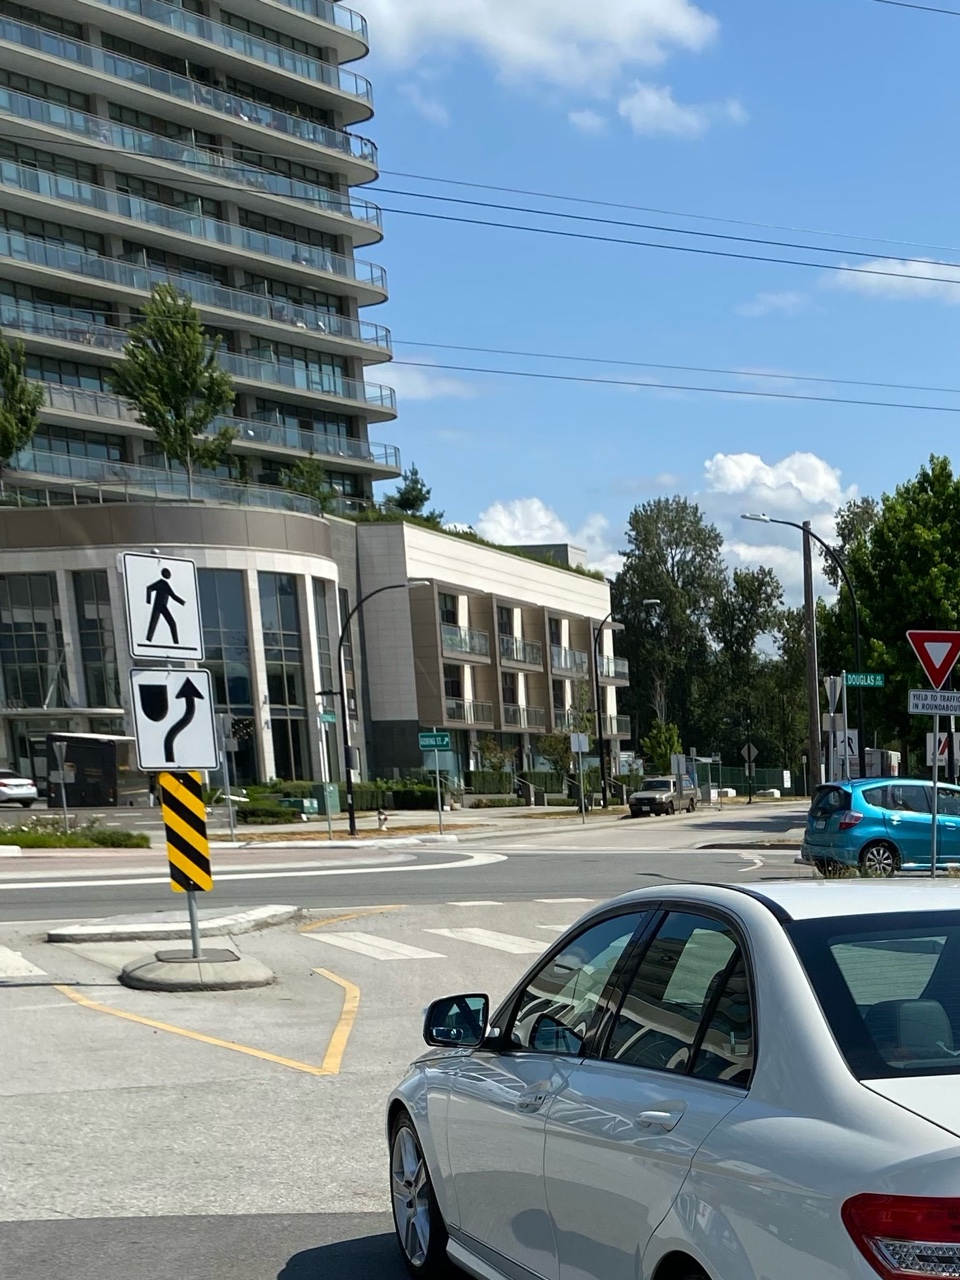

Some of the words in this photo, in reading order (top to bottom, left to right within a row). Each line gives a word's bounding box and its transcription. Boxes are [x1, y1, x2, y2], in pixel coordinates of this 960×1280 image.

[847, 674, 874, 686] DOUGLAS
[912, 693, 928, 702] YIELD
[930, 694, 938, 702] TO
[912, 702, 919, 710] IN
[921, 703, 960, 712] ROUNDABOUT
